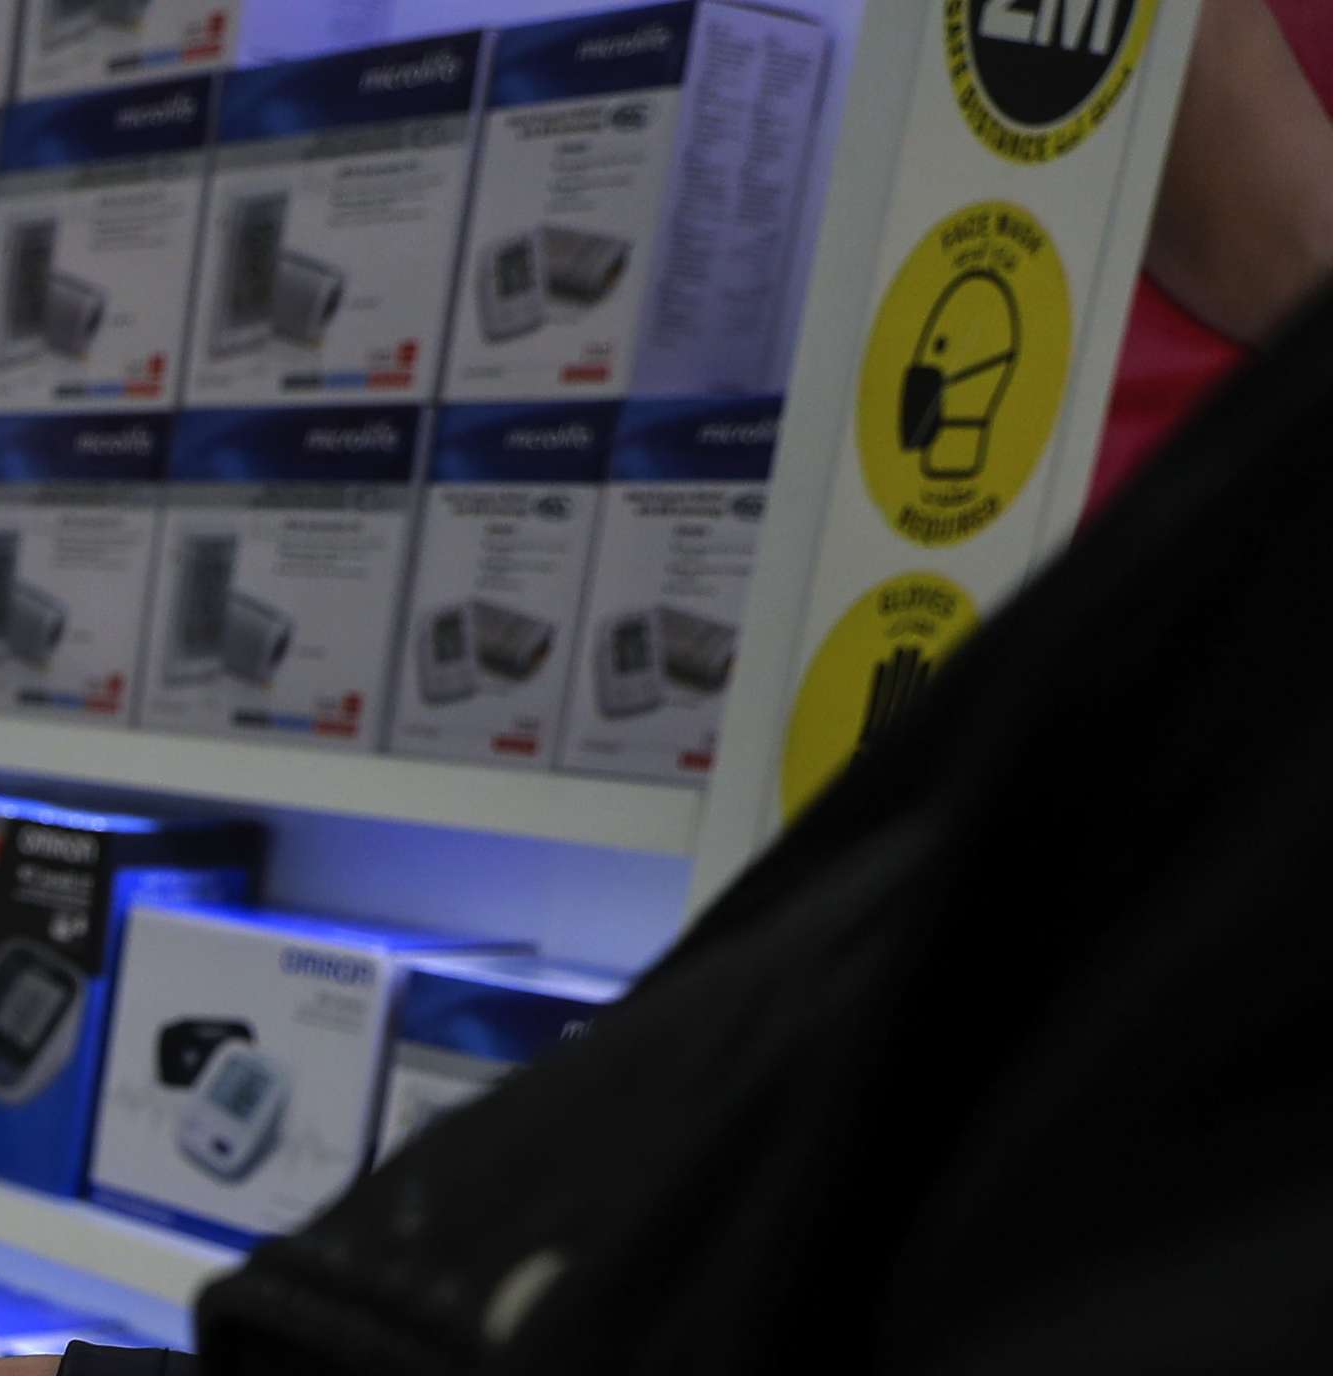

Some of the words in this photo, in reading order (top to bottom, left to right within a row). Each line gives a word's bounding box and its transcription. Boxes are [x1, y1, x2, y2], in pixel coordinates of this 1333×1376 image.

[576, 22, 671, 66] microlife
[360, 51, 462, 97] microlife
[115, 92, 198, 132] microlife
[75, 424, 153, 460] microlife
[307, 418, 400, 457] microlife
[504, 422, 591, 454] microlife
[279, 946, 376, 986] OMRON
